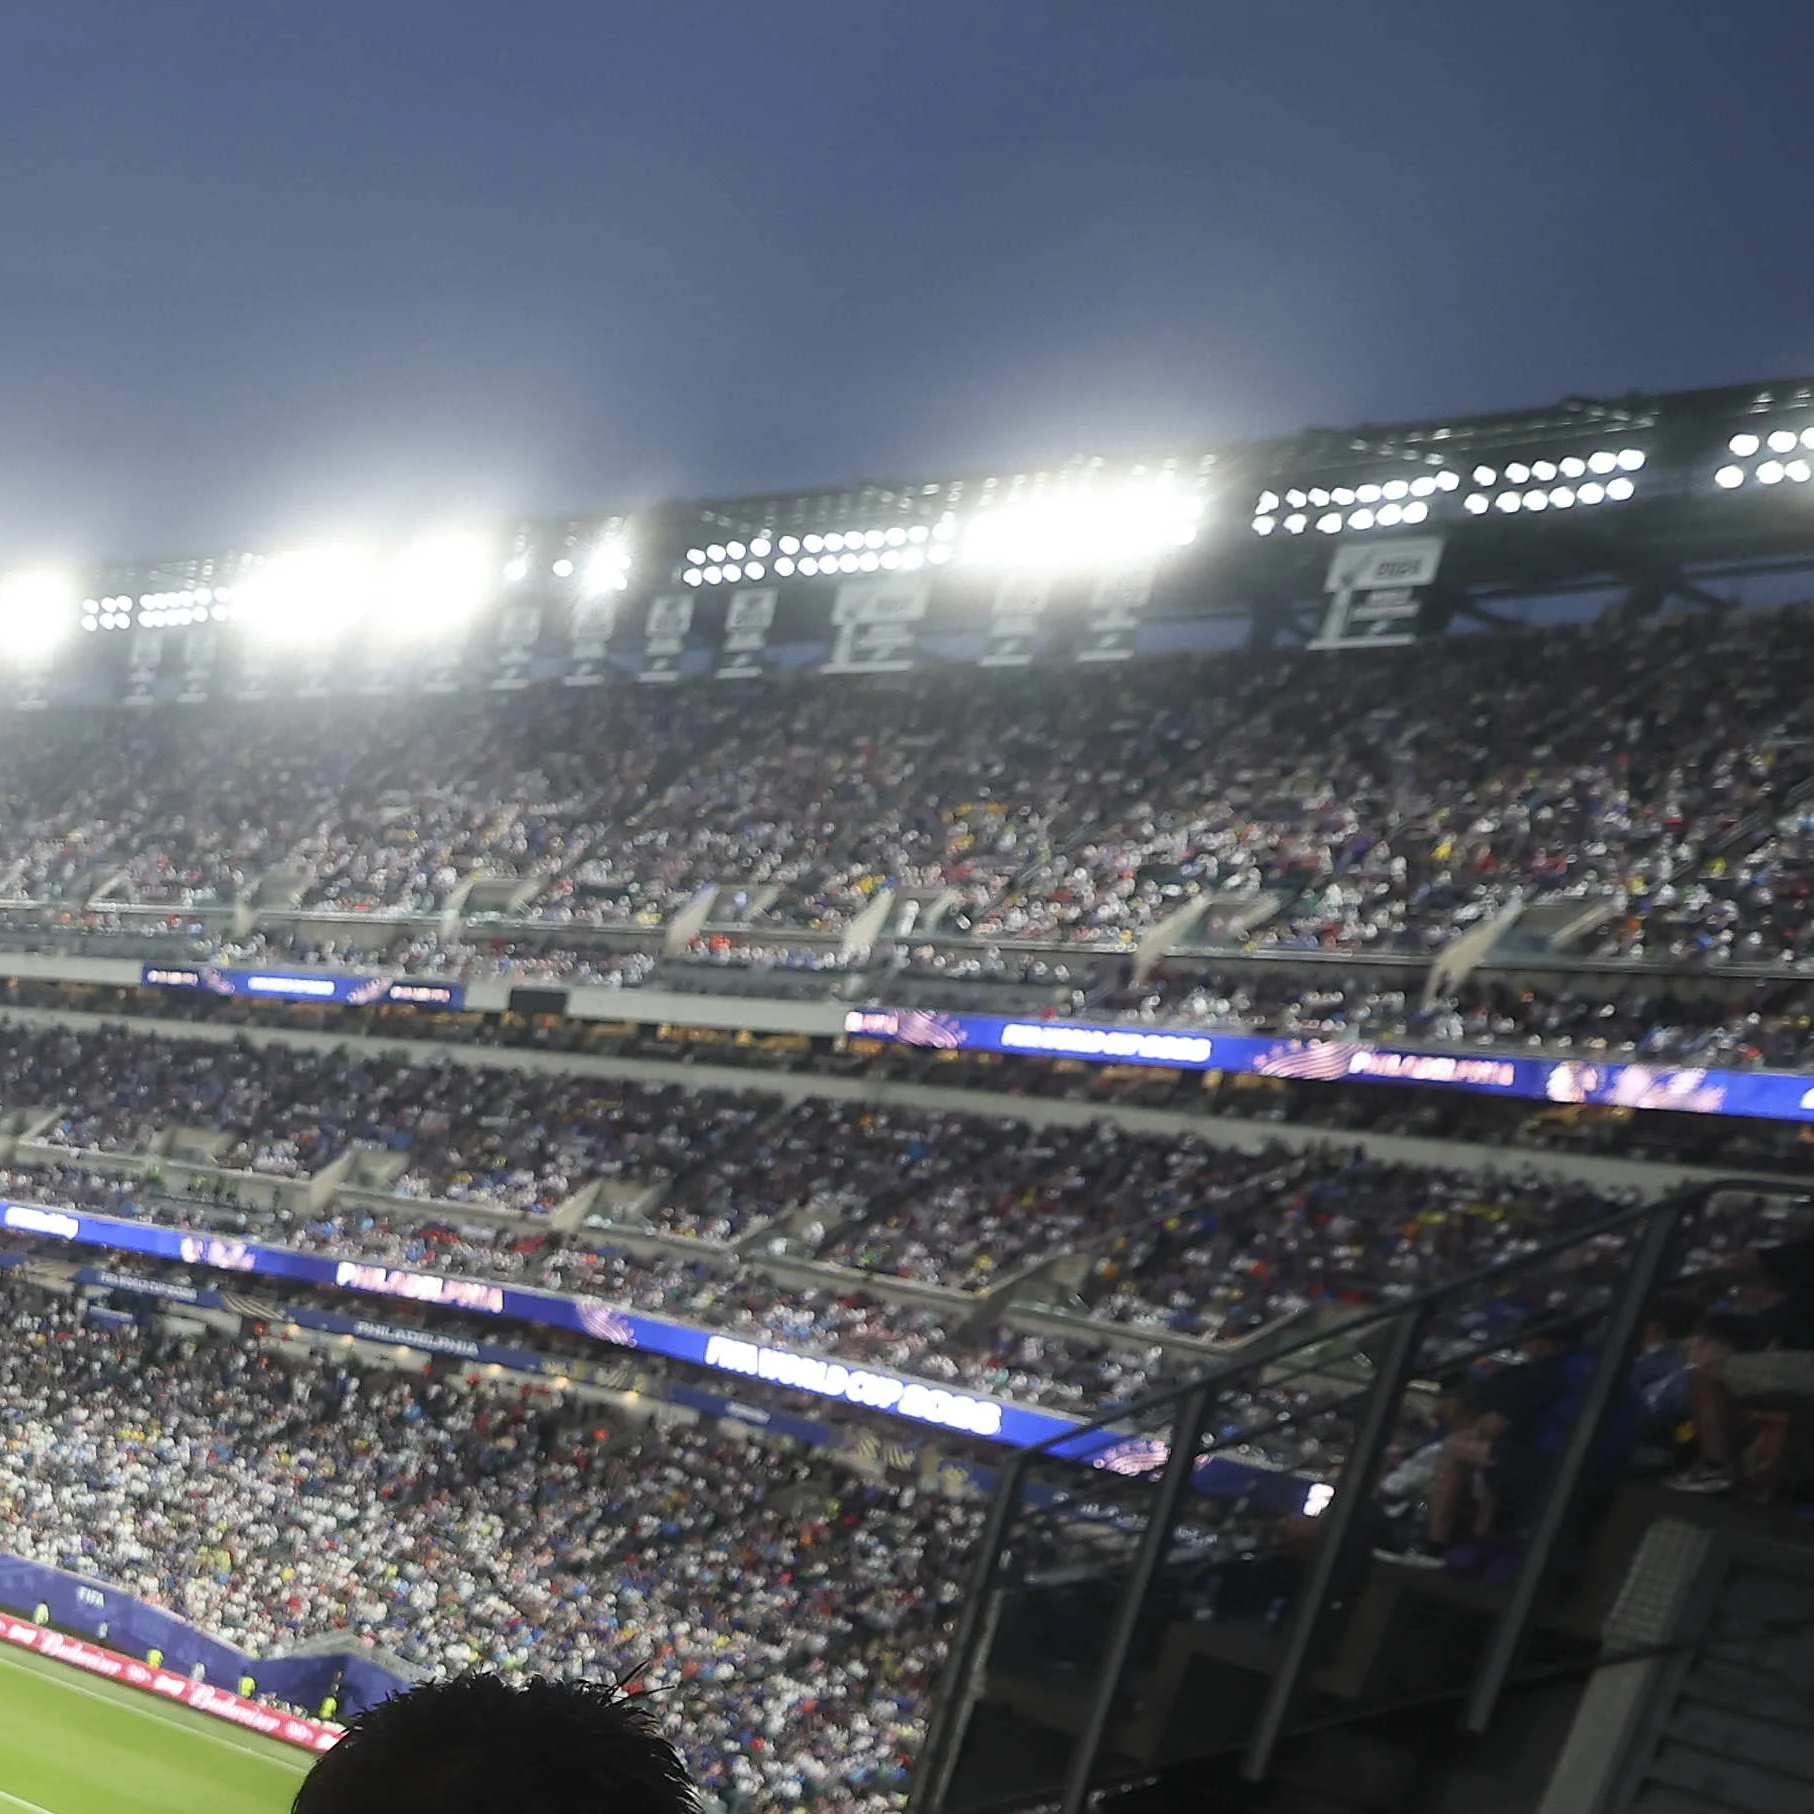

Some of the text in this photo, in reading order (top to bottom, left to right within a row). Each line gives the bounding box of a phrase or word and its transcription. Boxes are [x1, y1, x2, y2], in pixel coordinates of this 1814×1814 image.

[354, 1320, 479, 1357] PHILADELPHIA
[76, 1584, 105, 1609] FIFA
[39, 1629, 124, 1676] Budweiser
[188, 1679, 282, 1732] Budweiser
